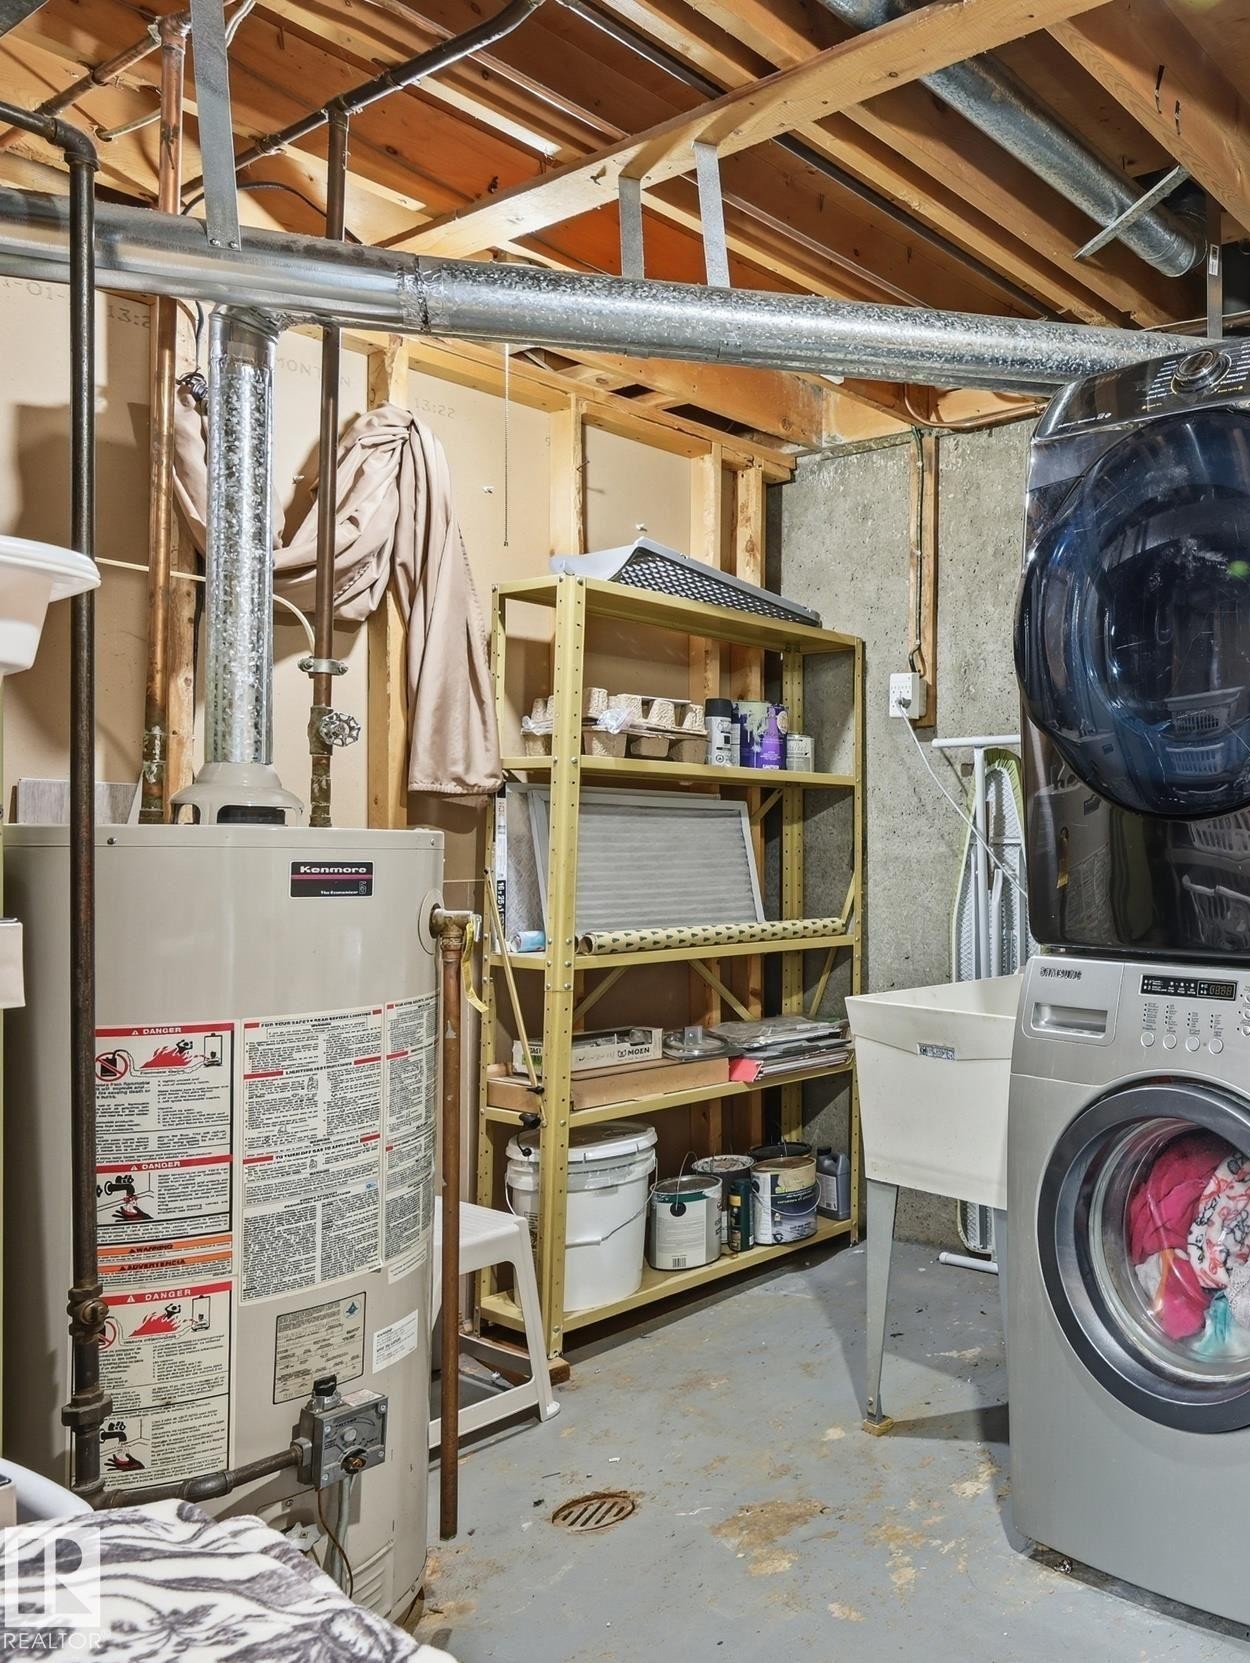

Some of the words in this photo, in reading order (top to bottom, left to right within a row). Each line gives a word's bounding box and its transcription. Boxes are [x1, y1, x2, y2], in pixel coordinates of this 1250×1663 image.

[299, 865, 367, 874] Kenmore
[142, 1027, 182, 1035] DANGER
[627, 1047, 651, 1057] MOEN
[141, 1161, 181, 1170] DANGER
[145, 1288, 192, 1301] DANGER
